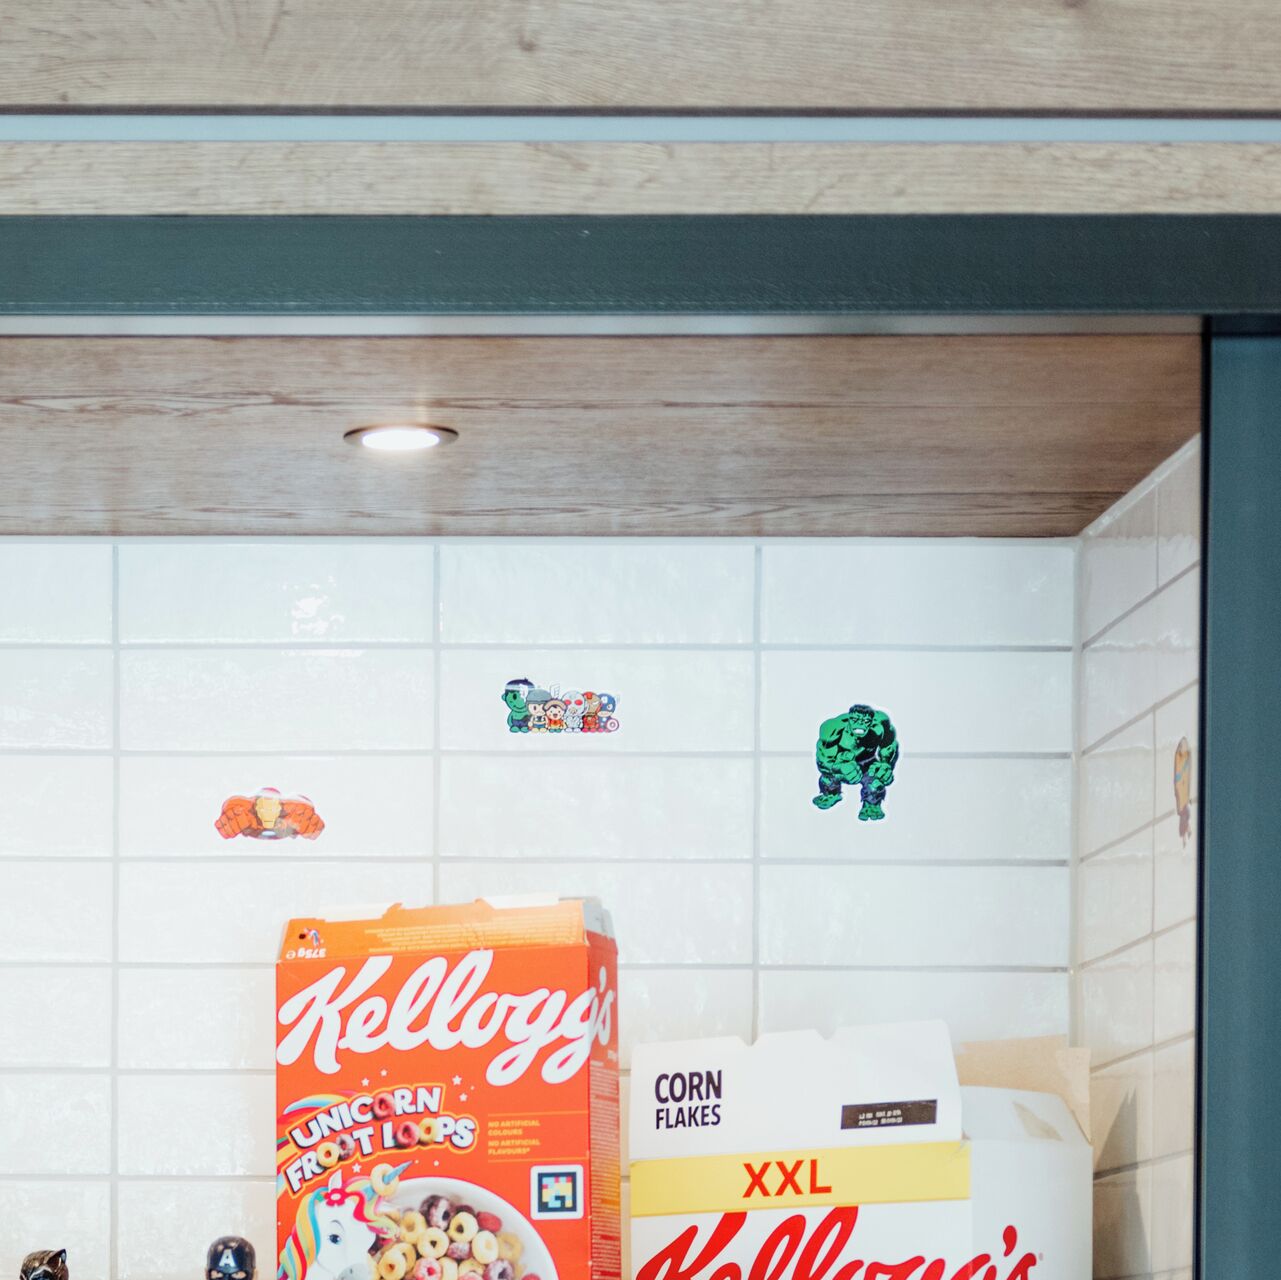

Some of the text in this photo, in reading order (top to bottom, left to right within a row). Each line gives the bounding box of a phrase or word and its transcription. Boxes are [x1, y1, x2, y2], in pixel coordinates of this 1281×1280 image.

[276, 949, 615, 1086] Kellogg's
[654, 1070, 722, 1104] CORN
[290, 1086, 442, 1149] UNICORN
[656, 1105, 721, 1130] FLAKES
[285, 1115, 477, 1194] FROOT LOOPS
[742, 1158, 832, 1198] XXL
